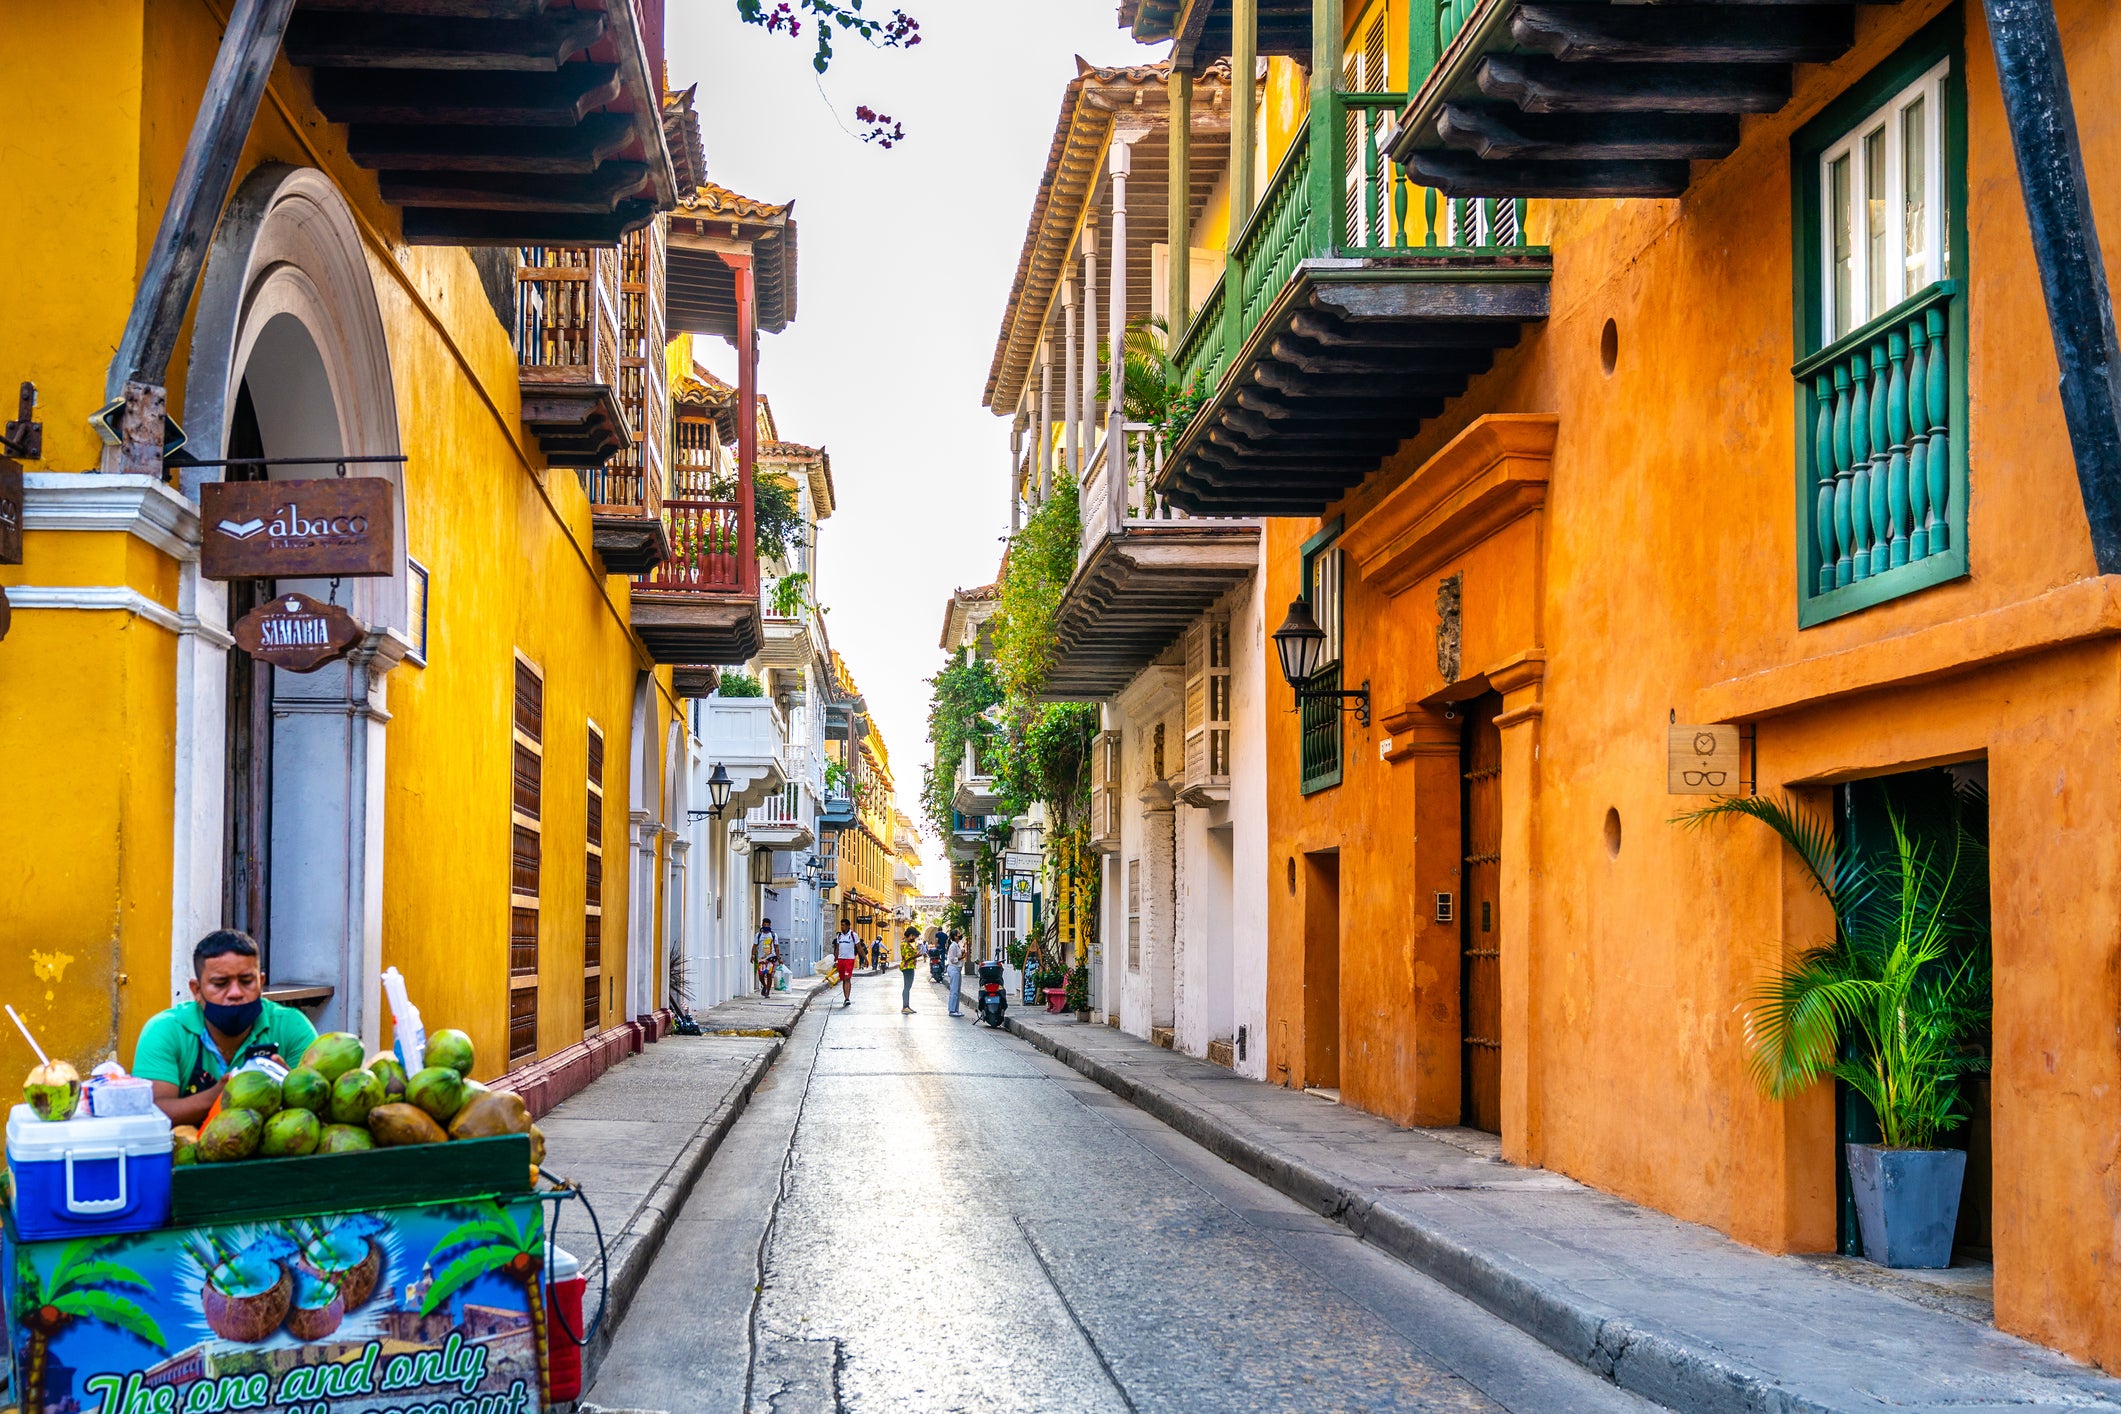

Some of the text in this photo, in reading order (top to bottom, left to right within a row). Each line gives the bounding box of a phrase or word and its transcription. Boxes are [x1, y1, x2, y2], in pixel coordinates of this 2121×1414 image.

[268, 503, 369, 537] ábaco
[260, 618, 329, 646] SAMARIA
[87, 1373, 176, 1414] The
[182, 1373, 269, 1414] one
[275, 1341, 380, 1403] and
[381, 1332, 486, 1394] only
